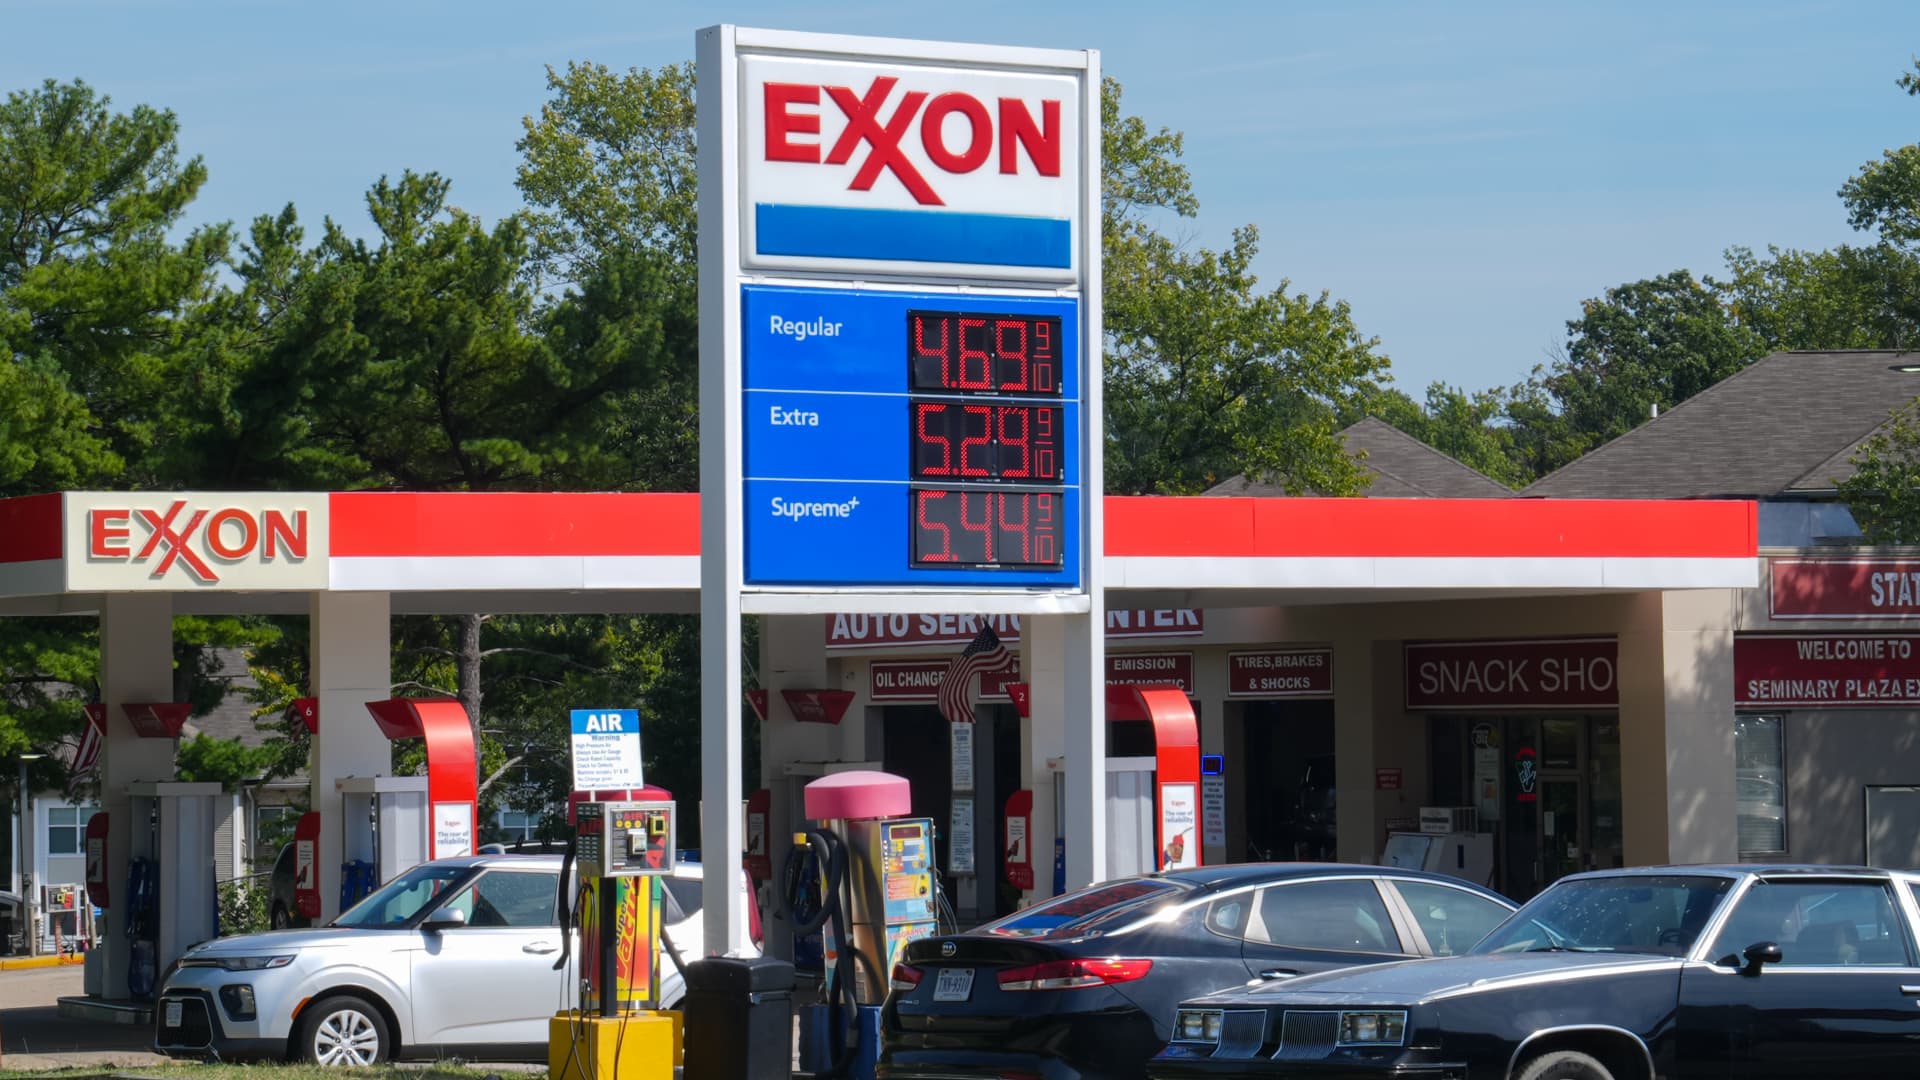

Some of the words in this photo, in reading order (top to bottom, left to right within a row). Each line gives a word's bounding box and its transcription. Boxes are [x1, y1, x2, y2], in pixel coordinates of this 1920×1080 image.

[763, 76, 1061, 206] EXXON
[770, 315, 842, 340] Regular
[915, 317, 1027, 390] 4.69
[770, 406, 819, 425] Extra
[918, 404, 1029, 478] 5.29
[772, 496, 860, 521] Supreme+
[919, 491, 1029, 562] 5.44
[90, 500, 308, 582] EXXON
[1871, 572, 1920, 606] STAT
[832, 613, 909, 640] AUTO
[1798, 641, 1884, 660] WELCOME
[1887, 640, 1911, 659] TO
[1114, 658, 1176, 671] EMISSION
[1419, 659, 1529, 695] SNACK
[876, 672, 895, 688] OIL
[1249, 677, 1258, 689] &
[1261, 677, 1312, 689] SHOCKS
[1748, 680, 1840, 699] SEMINARY
[1845, 679, 1902, 698] PLAZA
[1018, 692, 1025, 702] 2
[306, 706, 312, 716] 6
[586, 714, 623, 732] AIR
